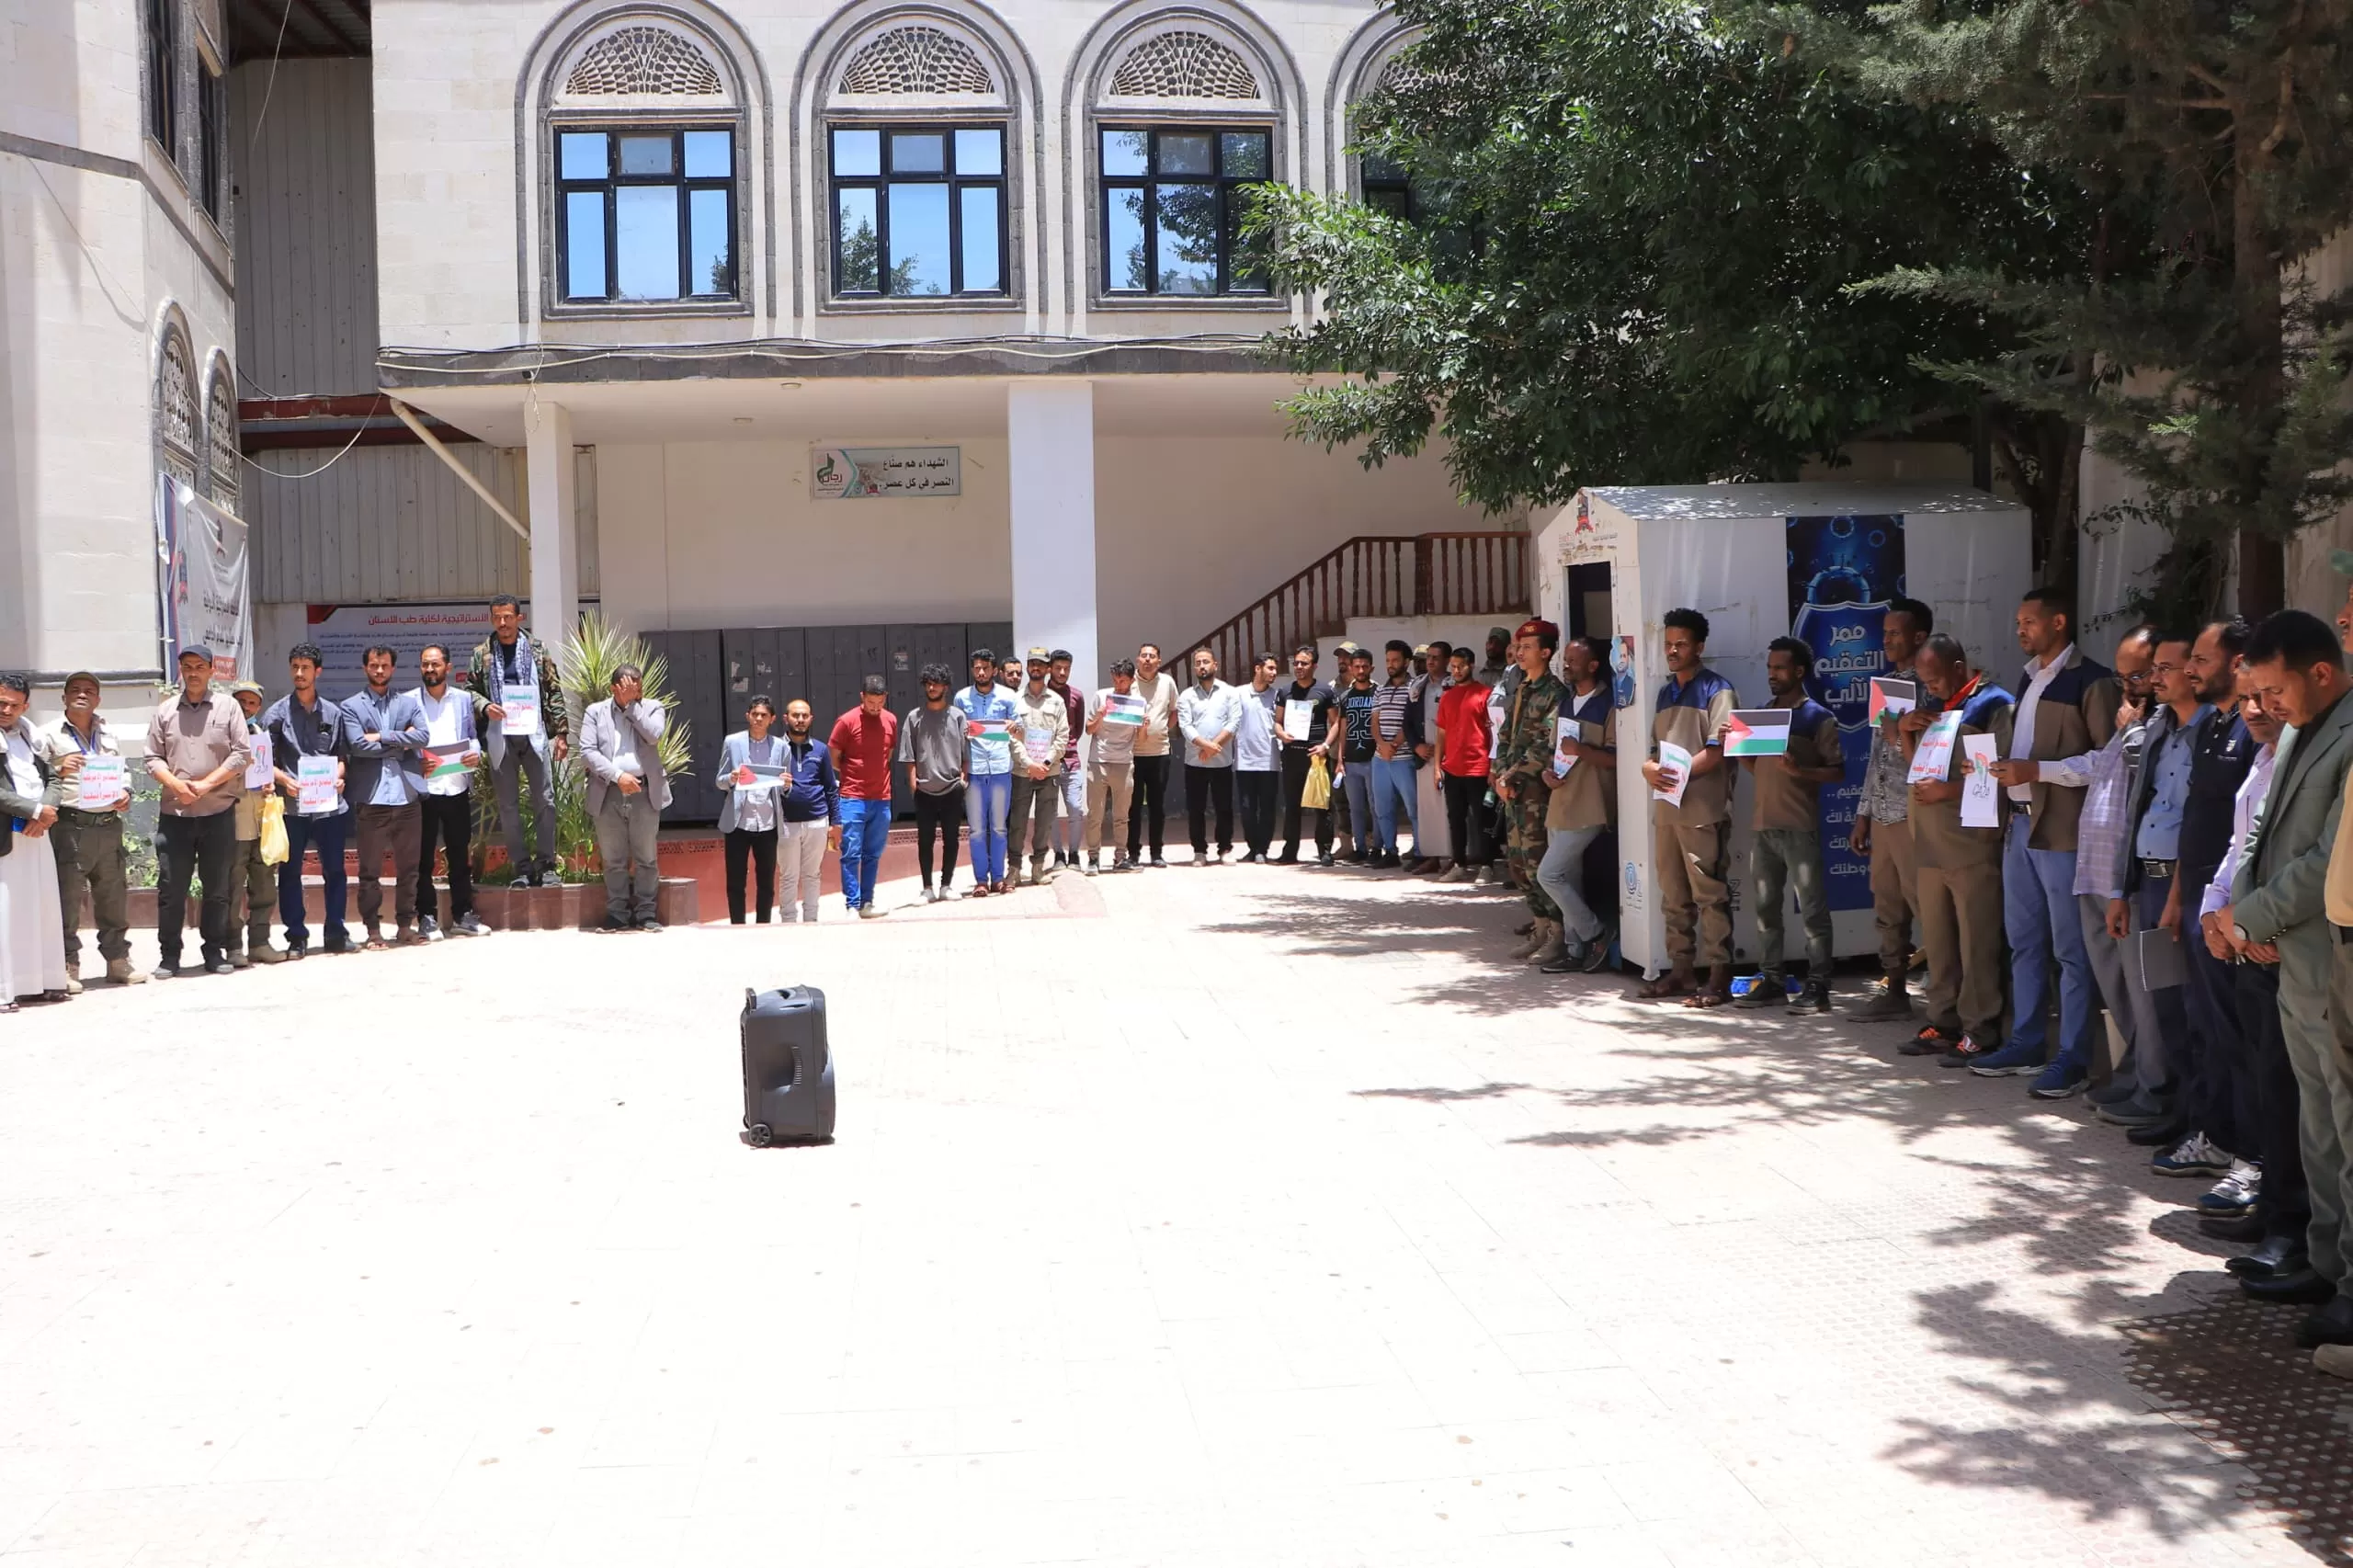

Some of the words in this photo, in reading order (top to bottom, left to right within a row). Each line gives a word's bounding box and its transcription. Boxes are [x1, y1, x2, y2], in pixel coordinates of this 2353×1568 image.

[918, 459, 949, 470] الشهداء
[905, 476, 916, 489] كل
[918, 480, 929, 491] في
[931, 478, 954, 489] النصر
[399, 613, 416, 625] طب
[1829, 625, 1866, 647] ممر
[1813, 649, 1885, 678] التعقيم
[1824, 676, 1870, 709] لآلي
[1346, 710, 1375, 741] 23
